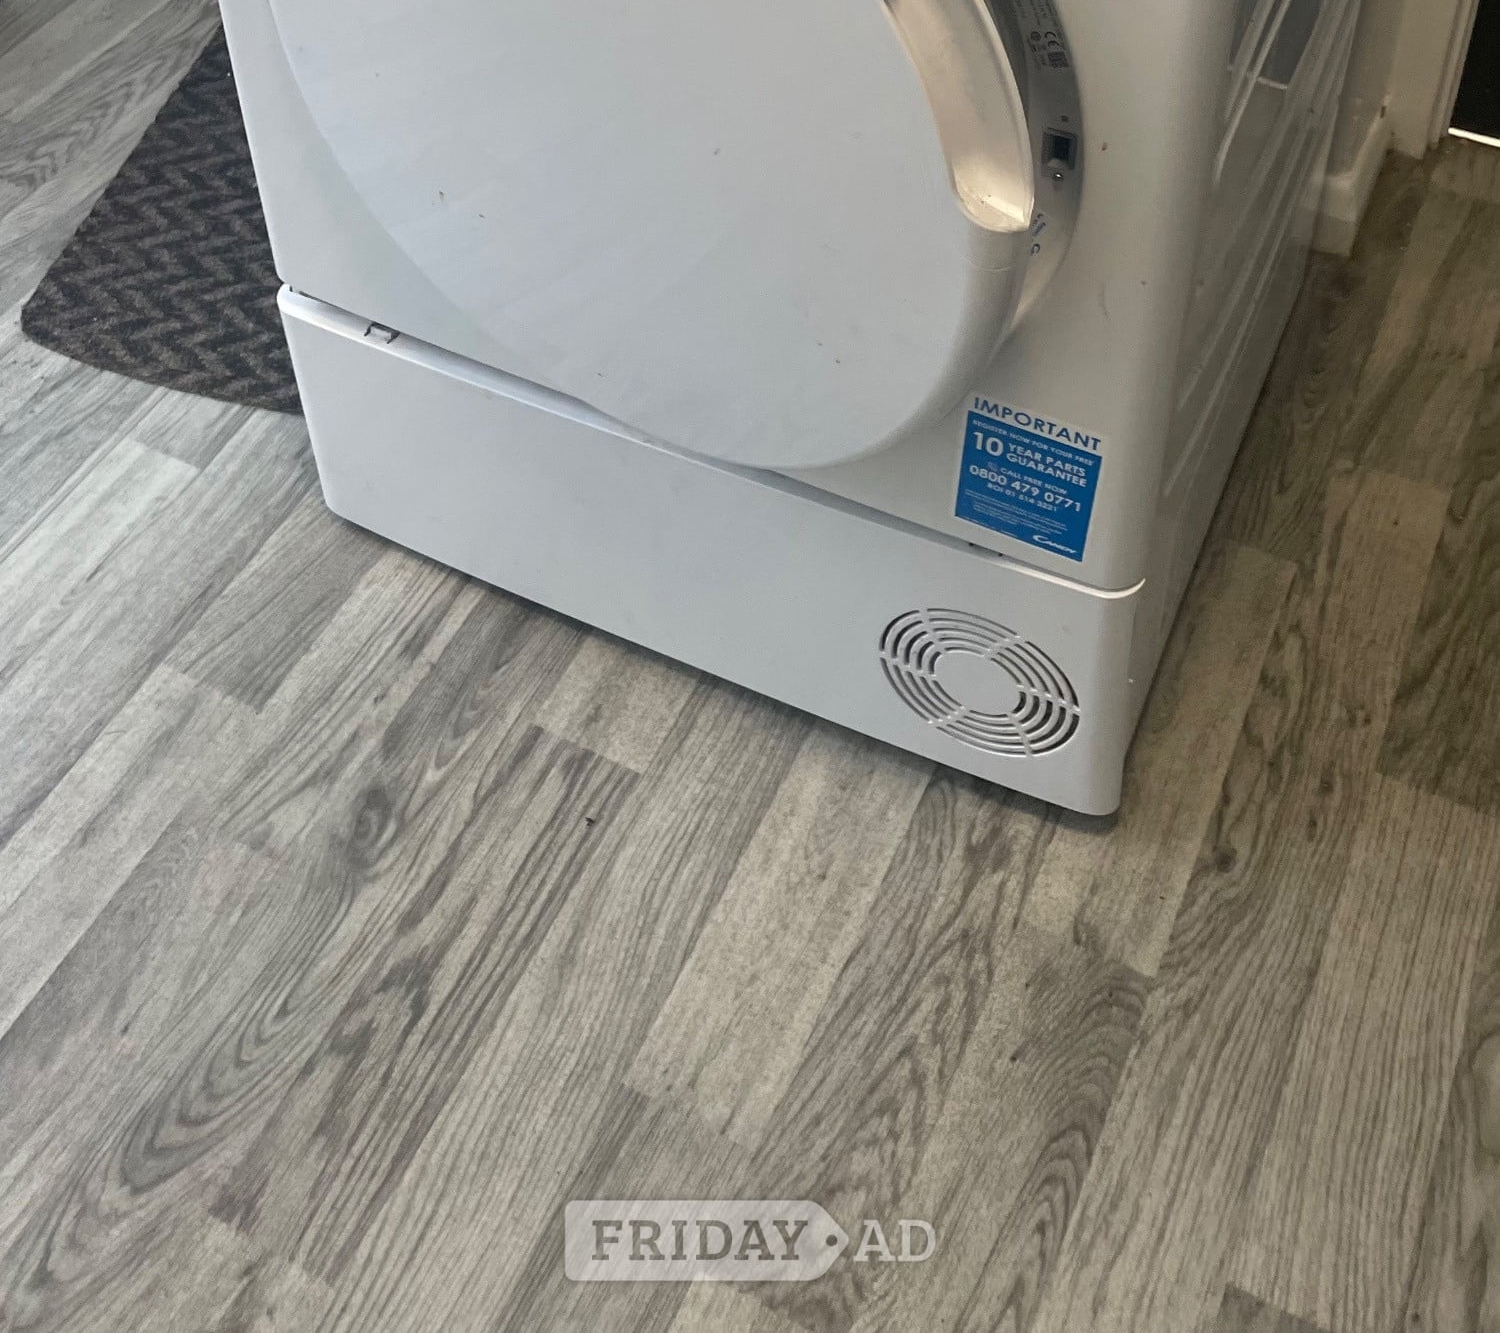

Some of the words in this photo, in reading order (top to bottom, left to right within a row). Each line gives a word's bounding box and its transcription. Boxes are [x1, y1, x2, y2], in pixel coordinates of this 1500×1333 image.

[974, 397, 1101, 450] IMPORTANT
[973, 431, 1004, 457] 10
[1008, 443, 1042, 461] YEAR
[1046, 456, 1086, 477] PARTS
[1010, 432, 1030, 444] NOW
[1031, 440, 1048, 451] FOR
[1051, 447, 1073, 459] YOUR
[1000, 467, 1021, 479] CALL
[1023, 475, 1043, 486] FREE
[1045, 484, 1067, 495] NOW
[1006, 453, 1087, 487] GUARANTEE
[969, 465, 1007, 485] 0800
[1011, 481, 1039, 496] 479
[1044, 492, 1081, 512] 0771
